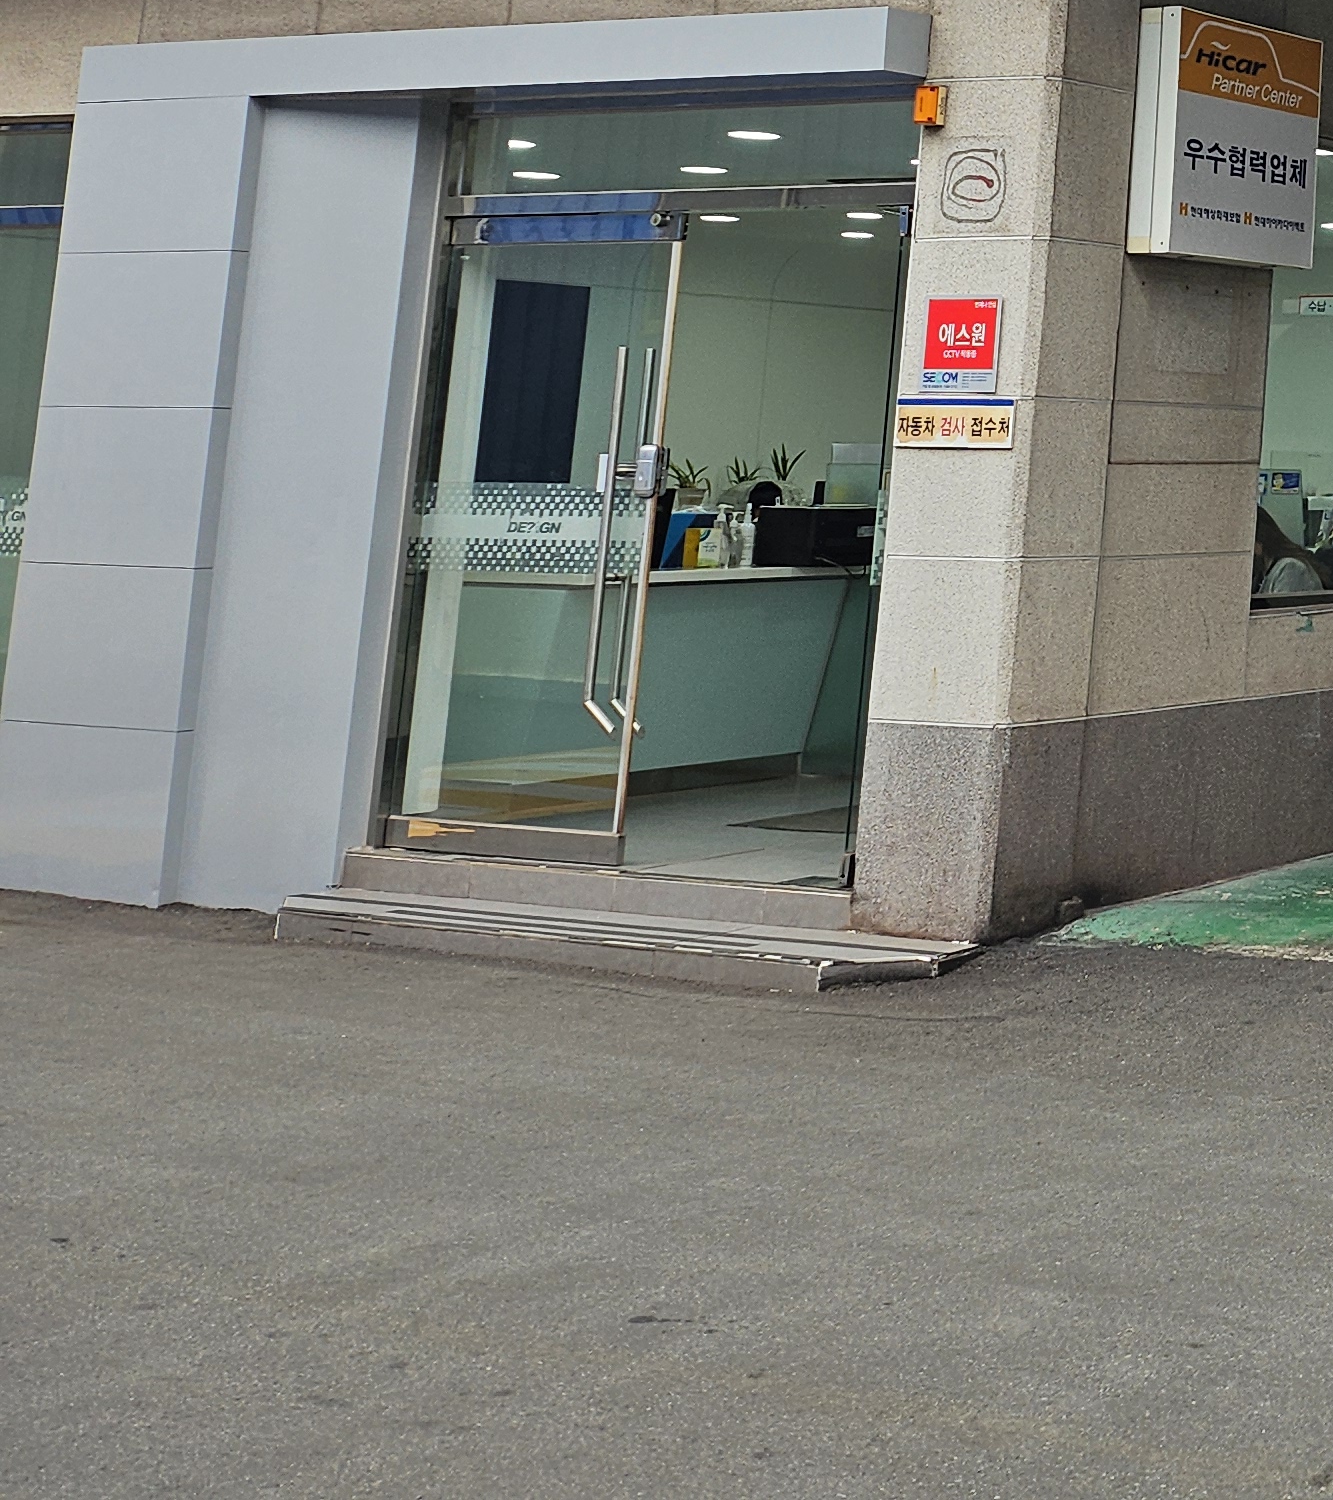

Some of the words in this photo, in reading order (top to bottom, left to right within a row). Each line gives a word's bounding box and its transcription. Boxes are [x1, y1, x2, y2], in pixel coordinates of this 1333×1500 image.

[1195, 48, 1267, 76] Hicar
[1211, 73, 1260, 99] Partner
[1261, 84, 1303, 108] Center
[1183, 138, 1308, 189] 우수협력업체
[1308, 301, 1327, 312] 수납
[938, 323, 986, 347] 에스원
[922, 372, 959, 383] SECOM
[898, 416, 935, 437] 자동차
[940, 416, 965, 437] 검사
[971, 417, 1010, 437] 접수처
